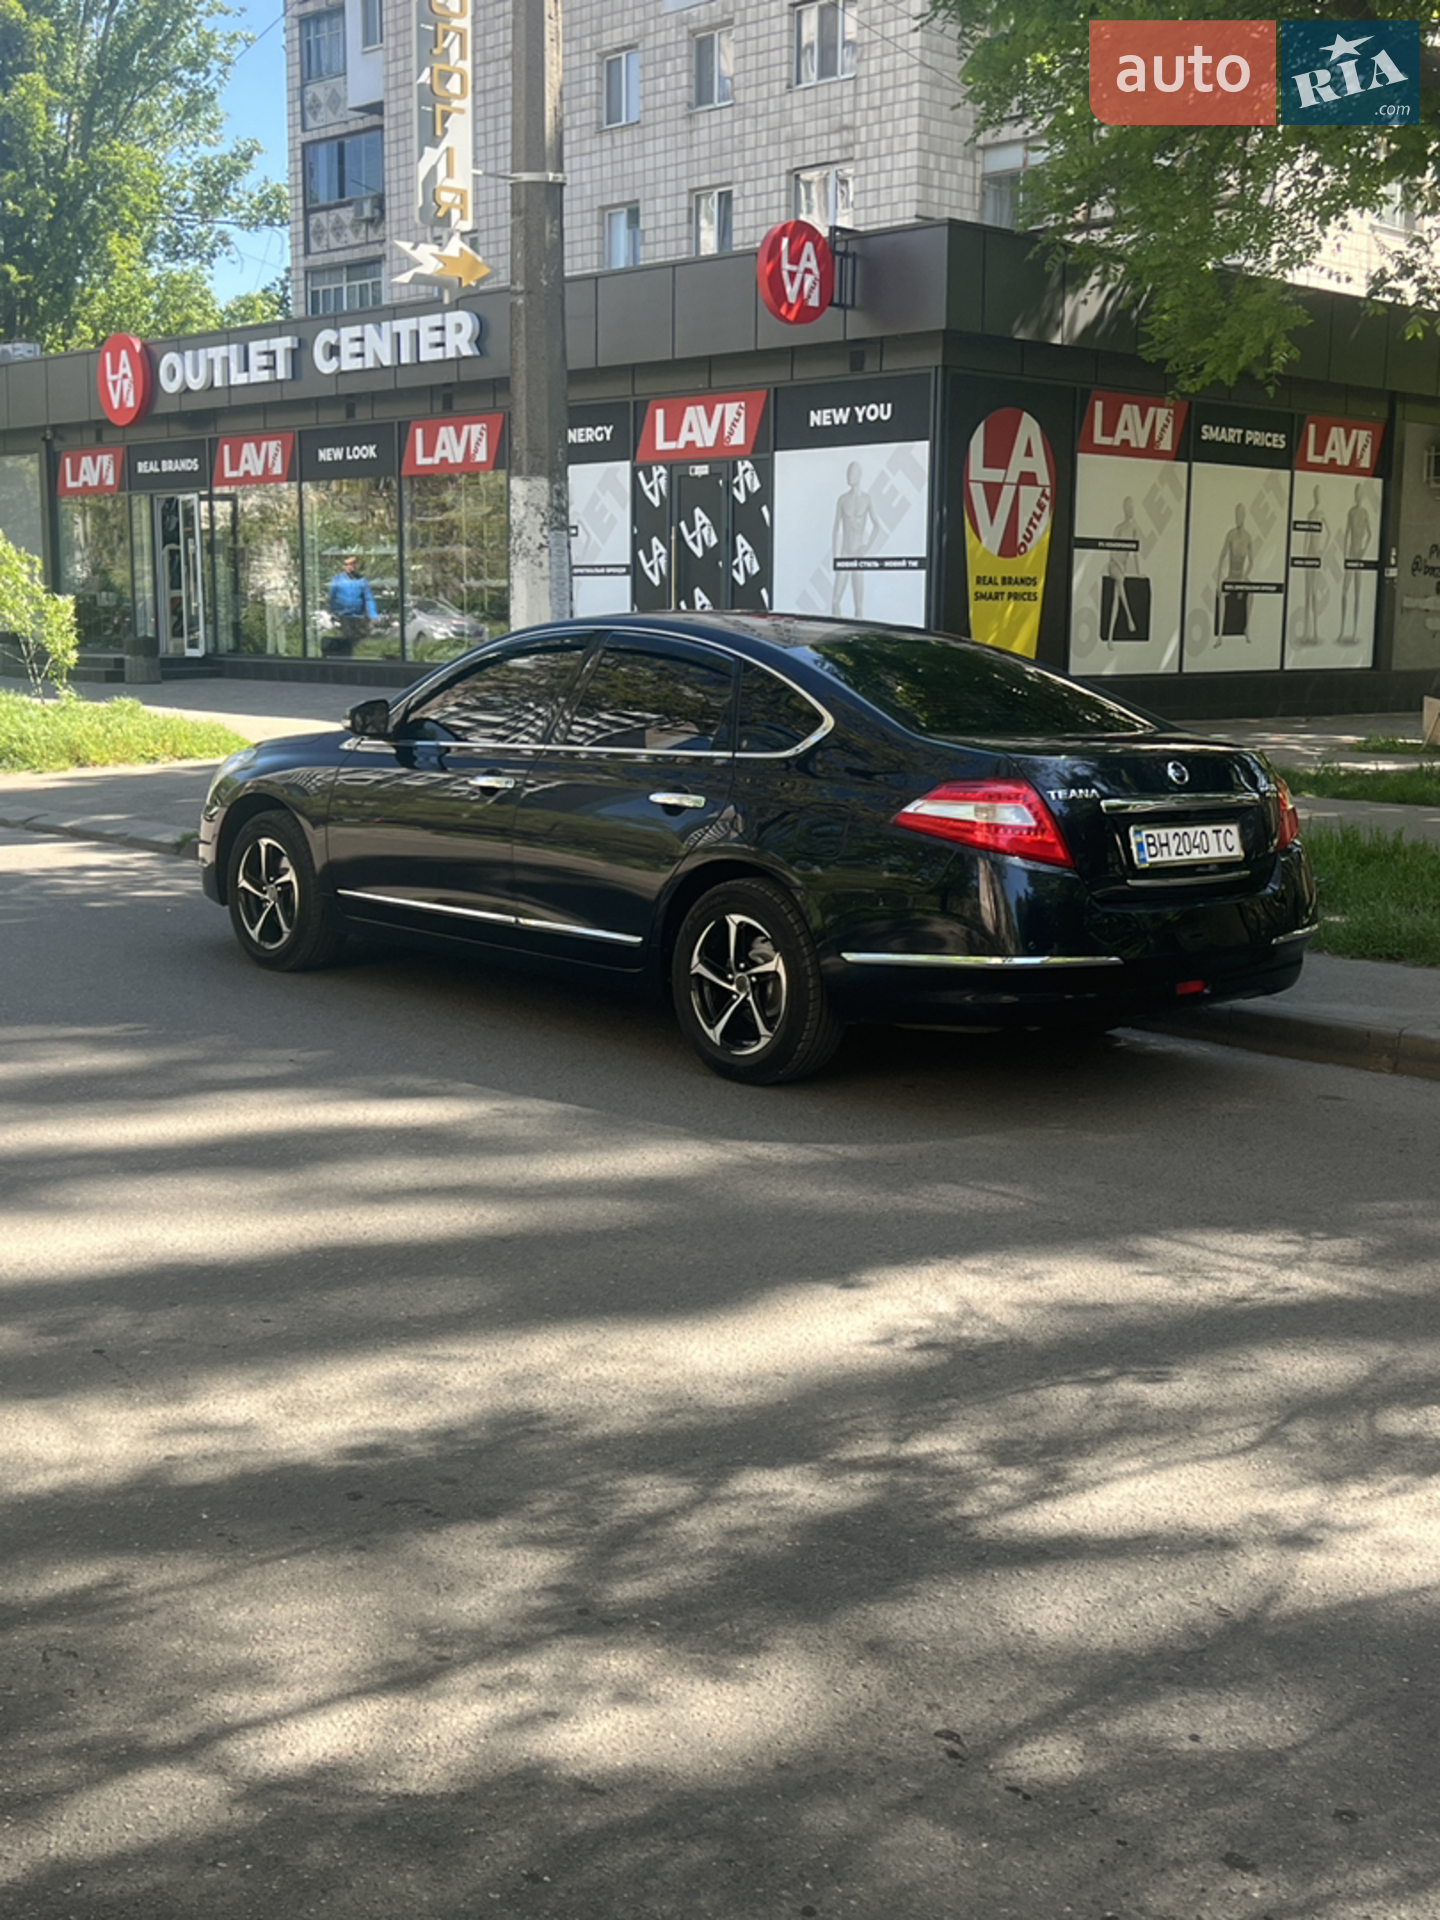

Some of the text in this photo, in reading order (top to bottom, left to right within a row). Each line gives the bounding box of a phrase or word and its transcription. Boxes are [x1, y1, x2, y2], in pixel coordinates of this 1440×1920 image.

[159, 310, 481, 394] OUTLET CENTER
[655, 402, 745, 450] LAVI
[809, 403, 892, 427] NEW YOU
[1093, 400, 1174, 451] LAVI
[415, 423, 488, 466] LAVI
[568, 425, 614, 443] NERGY
[1201, 425, 1286, 449] SMART PRICES
[1307, 424, 1373, 468] LAVI
[137, 457, 199, 474] REAL BRANDS
[223, 440, 282, 477] LAVI
[318, 444, 377, 462] NEW LOOK
[65, 454, 114, 488] LAVI
[1017, 488, 1051, 556] OUTLET
[974, 591, 1038, 602] SMART PRICES
[976, 576, 1038, 587] REAL BRANDS
[1047, 788, 1100, 801] TEANA
[1145, 833, 1172, 858] BH
[1173, 830, 1210, 856] 2040
[1212, 828, 1235, 853] TC
